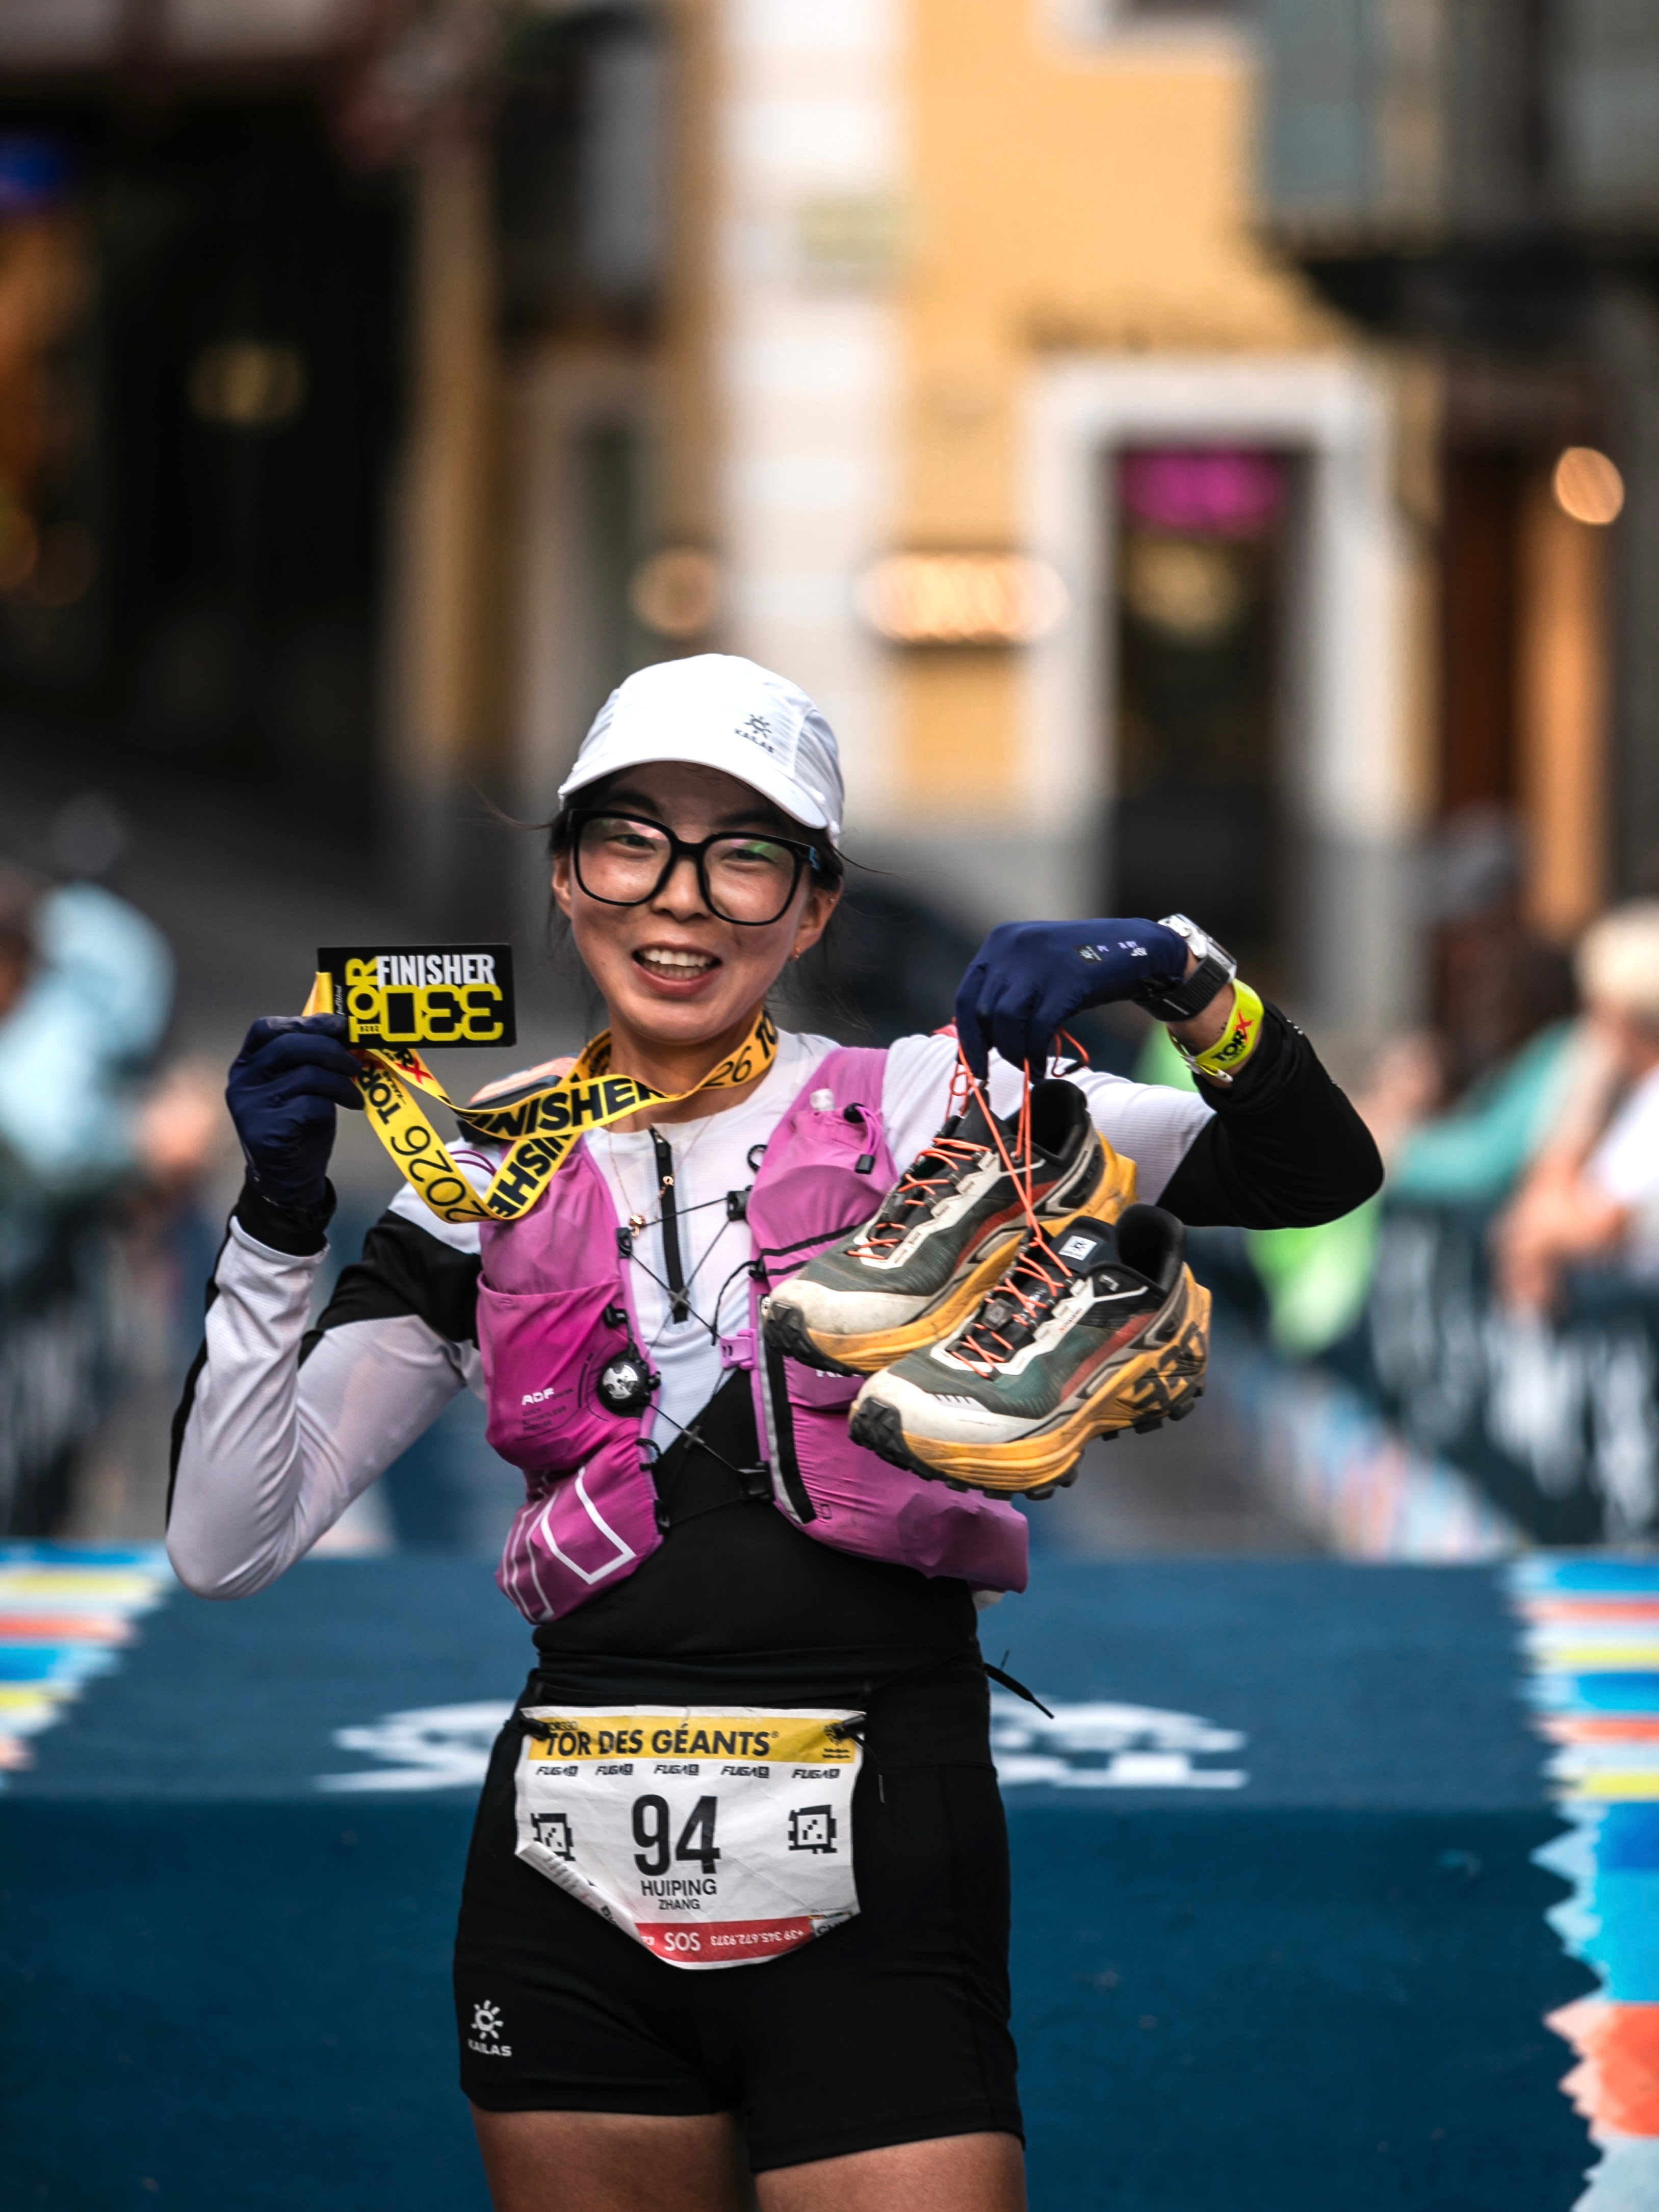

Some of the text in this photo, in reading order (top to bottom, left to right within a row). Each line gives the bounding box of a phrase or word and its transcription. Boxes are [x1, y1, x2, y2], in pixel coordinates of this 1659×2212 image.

[376, 954, 496, 988] FINISHER
[701, 1045, 751, 1083] 26
[454, 1070, 668, 1137] INISHE
[391, 1125, 490, 1222] 2026
[522, 1387, 555, 1406] ADF
[547, 1732, 591, 1757] TOR
[599, 1729, 643, 1755] DES
[632, 1794, 720, 1876] 94
[641, 1879, 717, 1896] HUIPING
[658, 1899, 700, 1910] ZHANG
[664, 1933, 701, 1952] SOS
